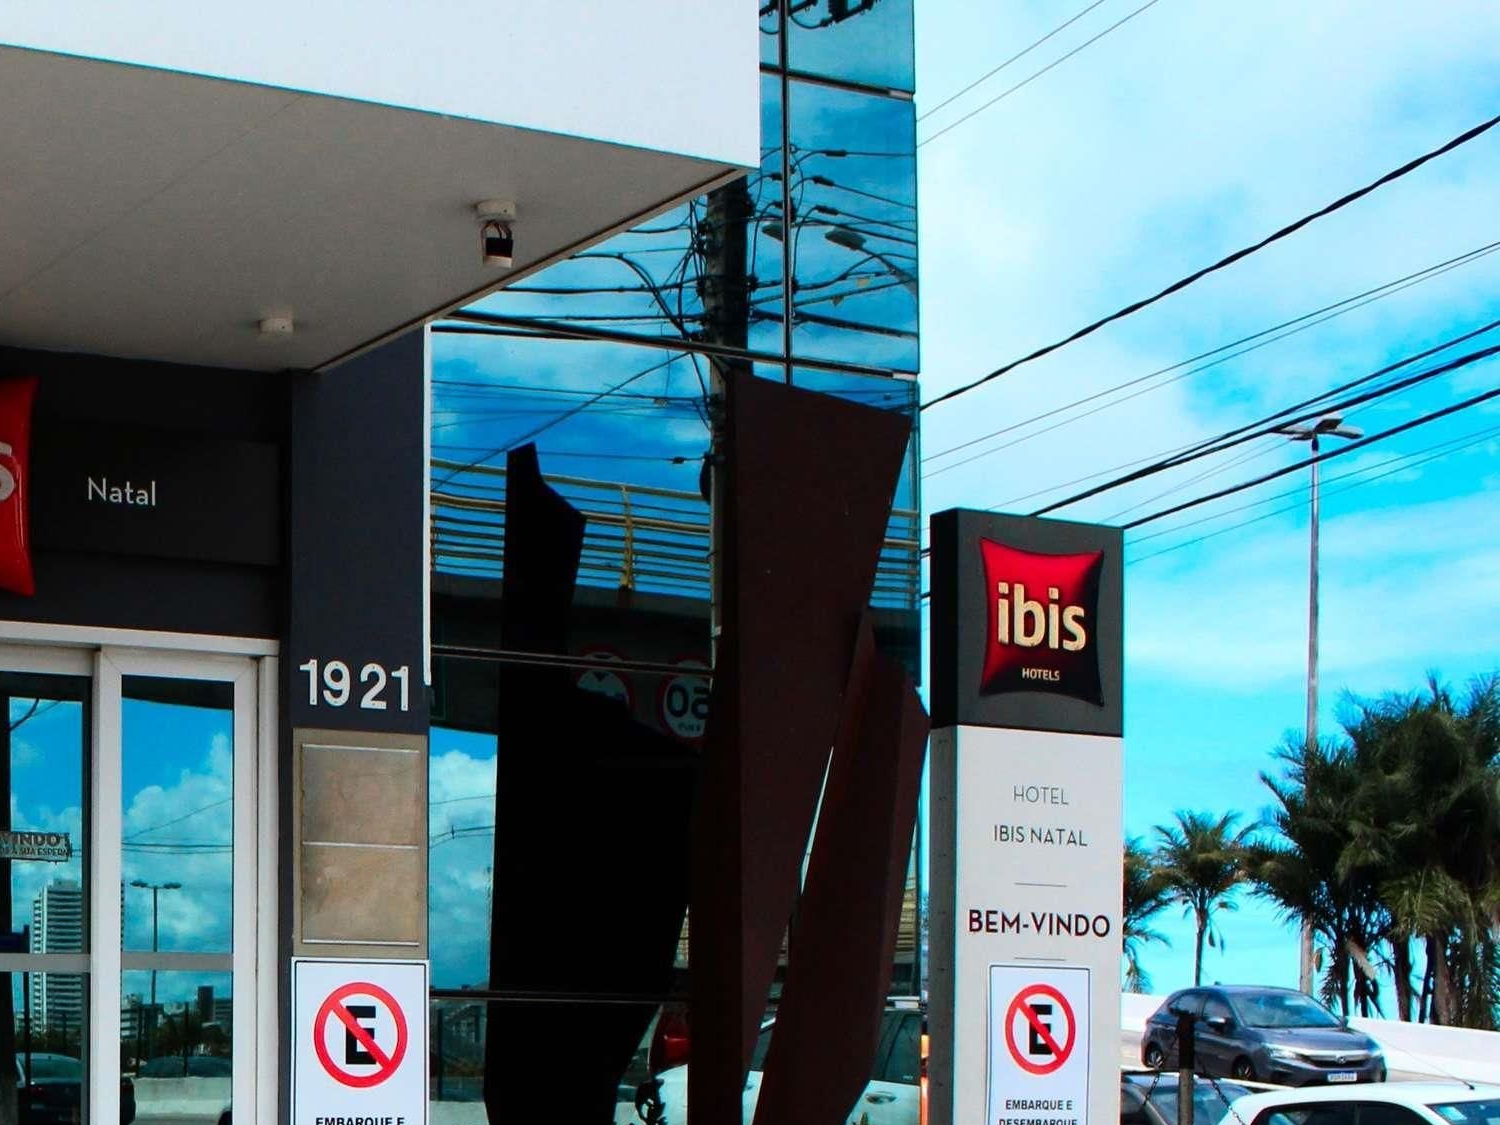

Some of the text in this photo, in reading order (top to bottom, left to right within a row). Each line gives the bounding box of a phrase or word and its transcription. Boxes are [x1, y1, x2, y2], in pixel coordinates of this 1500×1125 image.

[87, 476, 157, 507] Natal
[997, 581, 1087, 652] ibis
[298, 658, 409, 712] 1921
[1021, 666, 1060, 682] HOTELS
[1013, 785, 1069, 806] HOTEL
[993, 824, 1088, 848] IBIS NATAL
[968, 908, 1111, 939] BEM-VINDO
[1005, 1099, 1073, 1111] EMBARQUE E
